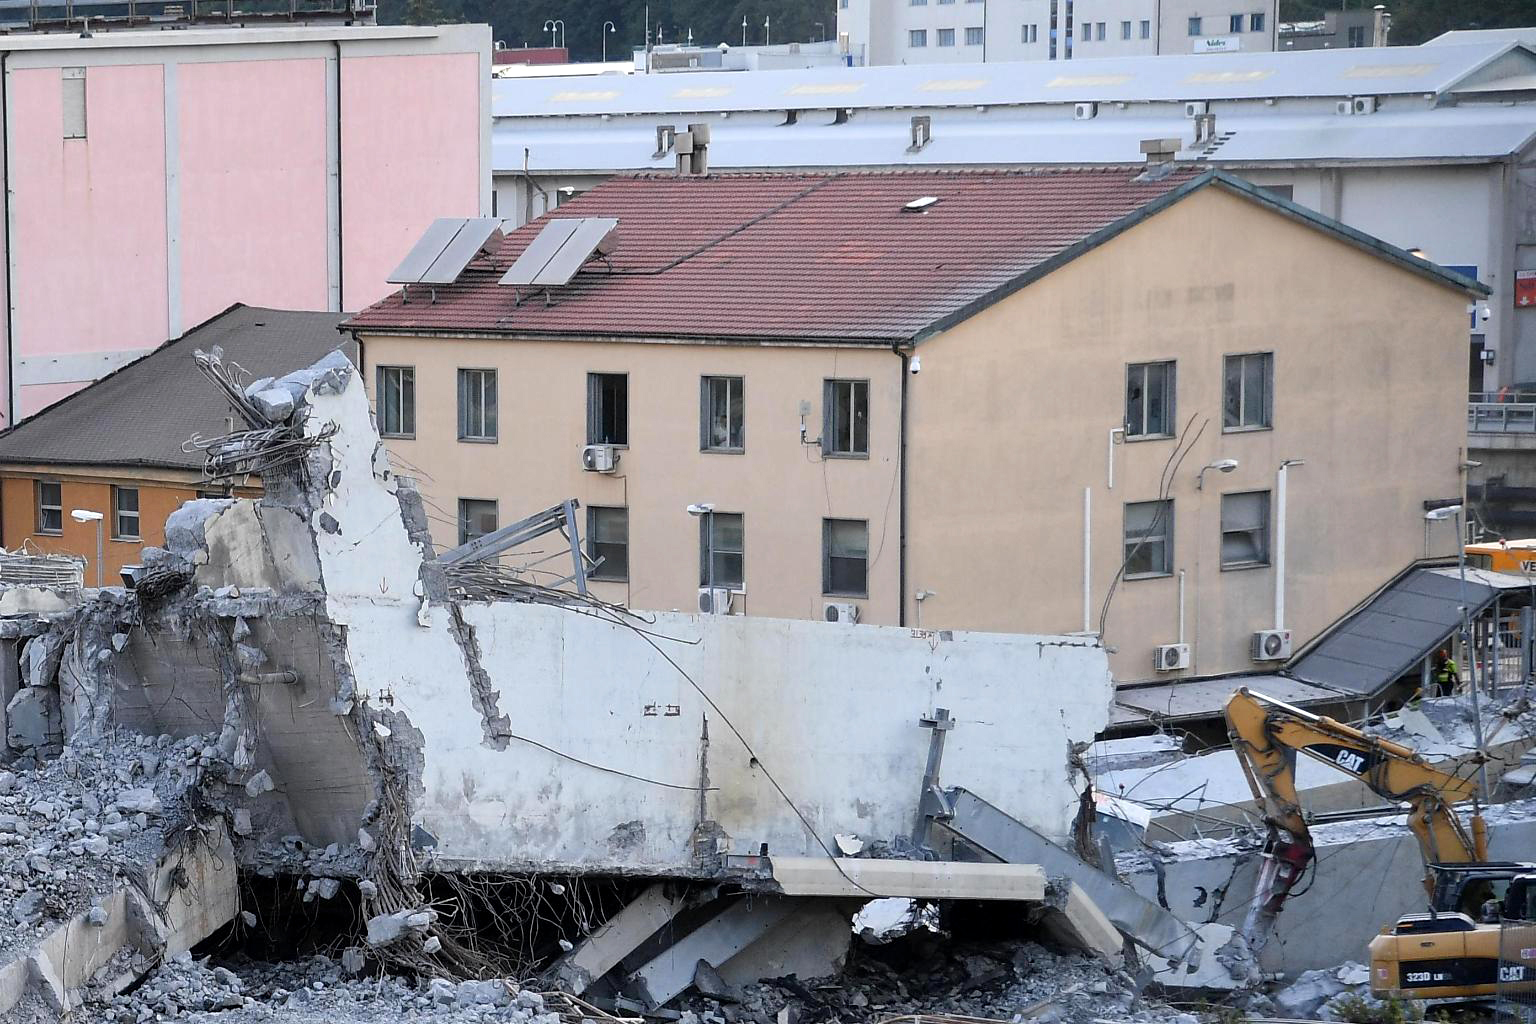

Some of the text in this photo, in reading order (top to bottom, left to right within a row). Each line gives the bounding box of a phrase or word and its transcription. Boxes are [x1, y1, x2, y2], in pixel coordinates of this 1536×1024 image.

[1336, 749, 1365, 772] CAT
[1406, 972, 1431, 982] 323D
[1499, 966, 1525, 982] CAT
